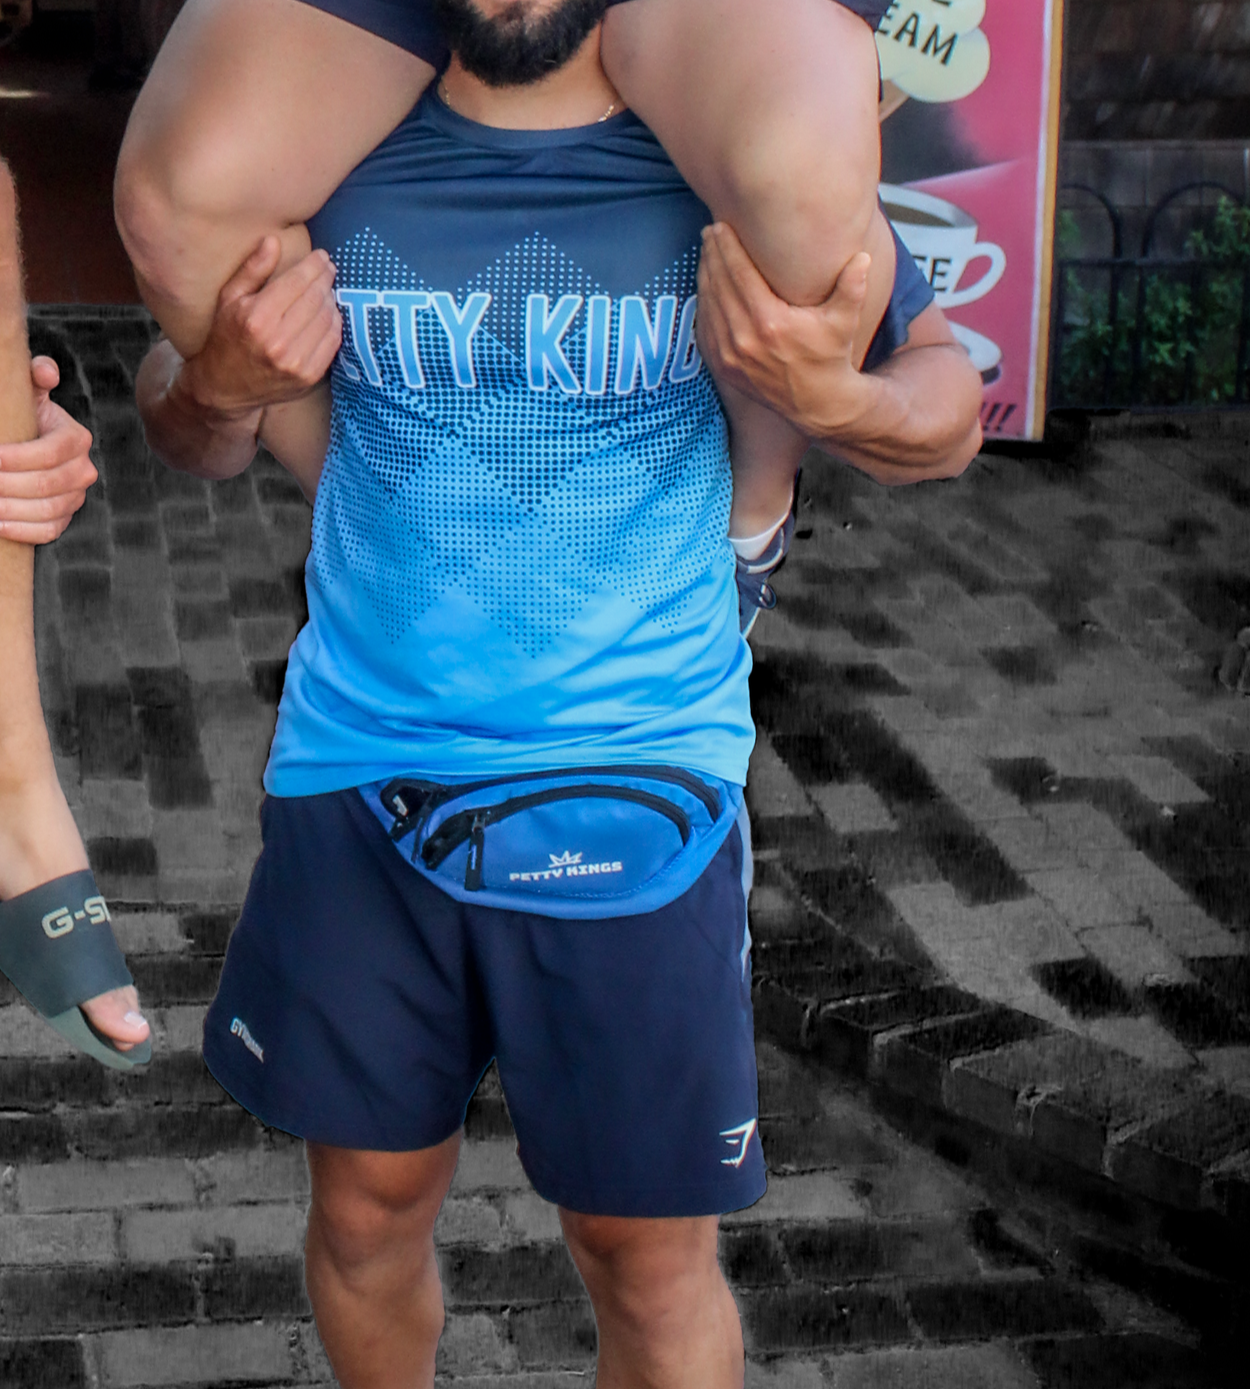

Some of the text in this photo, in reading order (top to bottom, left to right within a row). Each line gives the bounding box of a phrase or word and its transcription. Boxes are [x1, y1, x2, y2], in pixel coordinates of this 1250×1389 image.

[335, 288, 491, 389] TTY
[566, 860, 623, 877] KINGS
[41, 895, 112, 939] G-S
